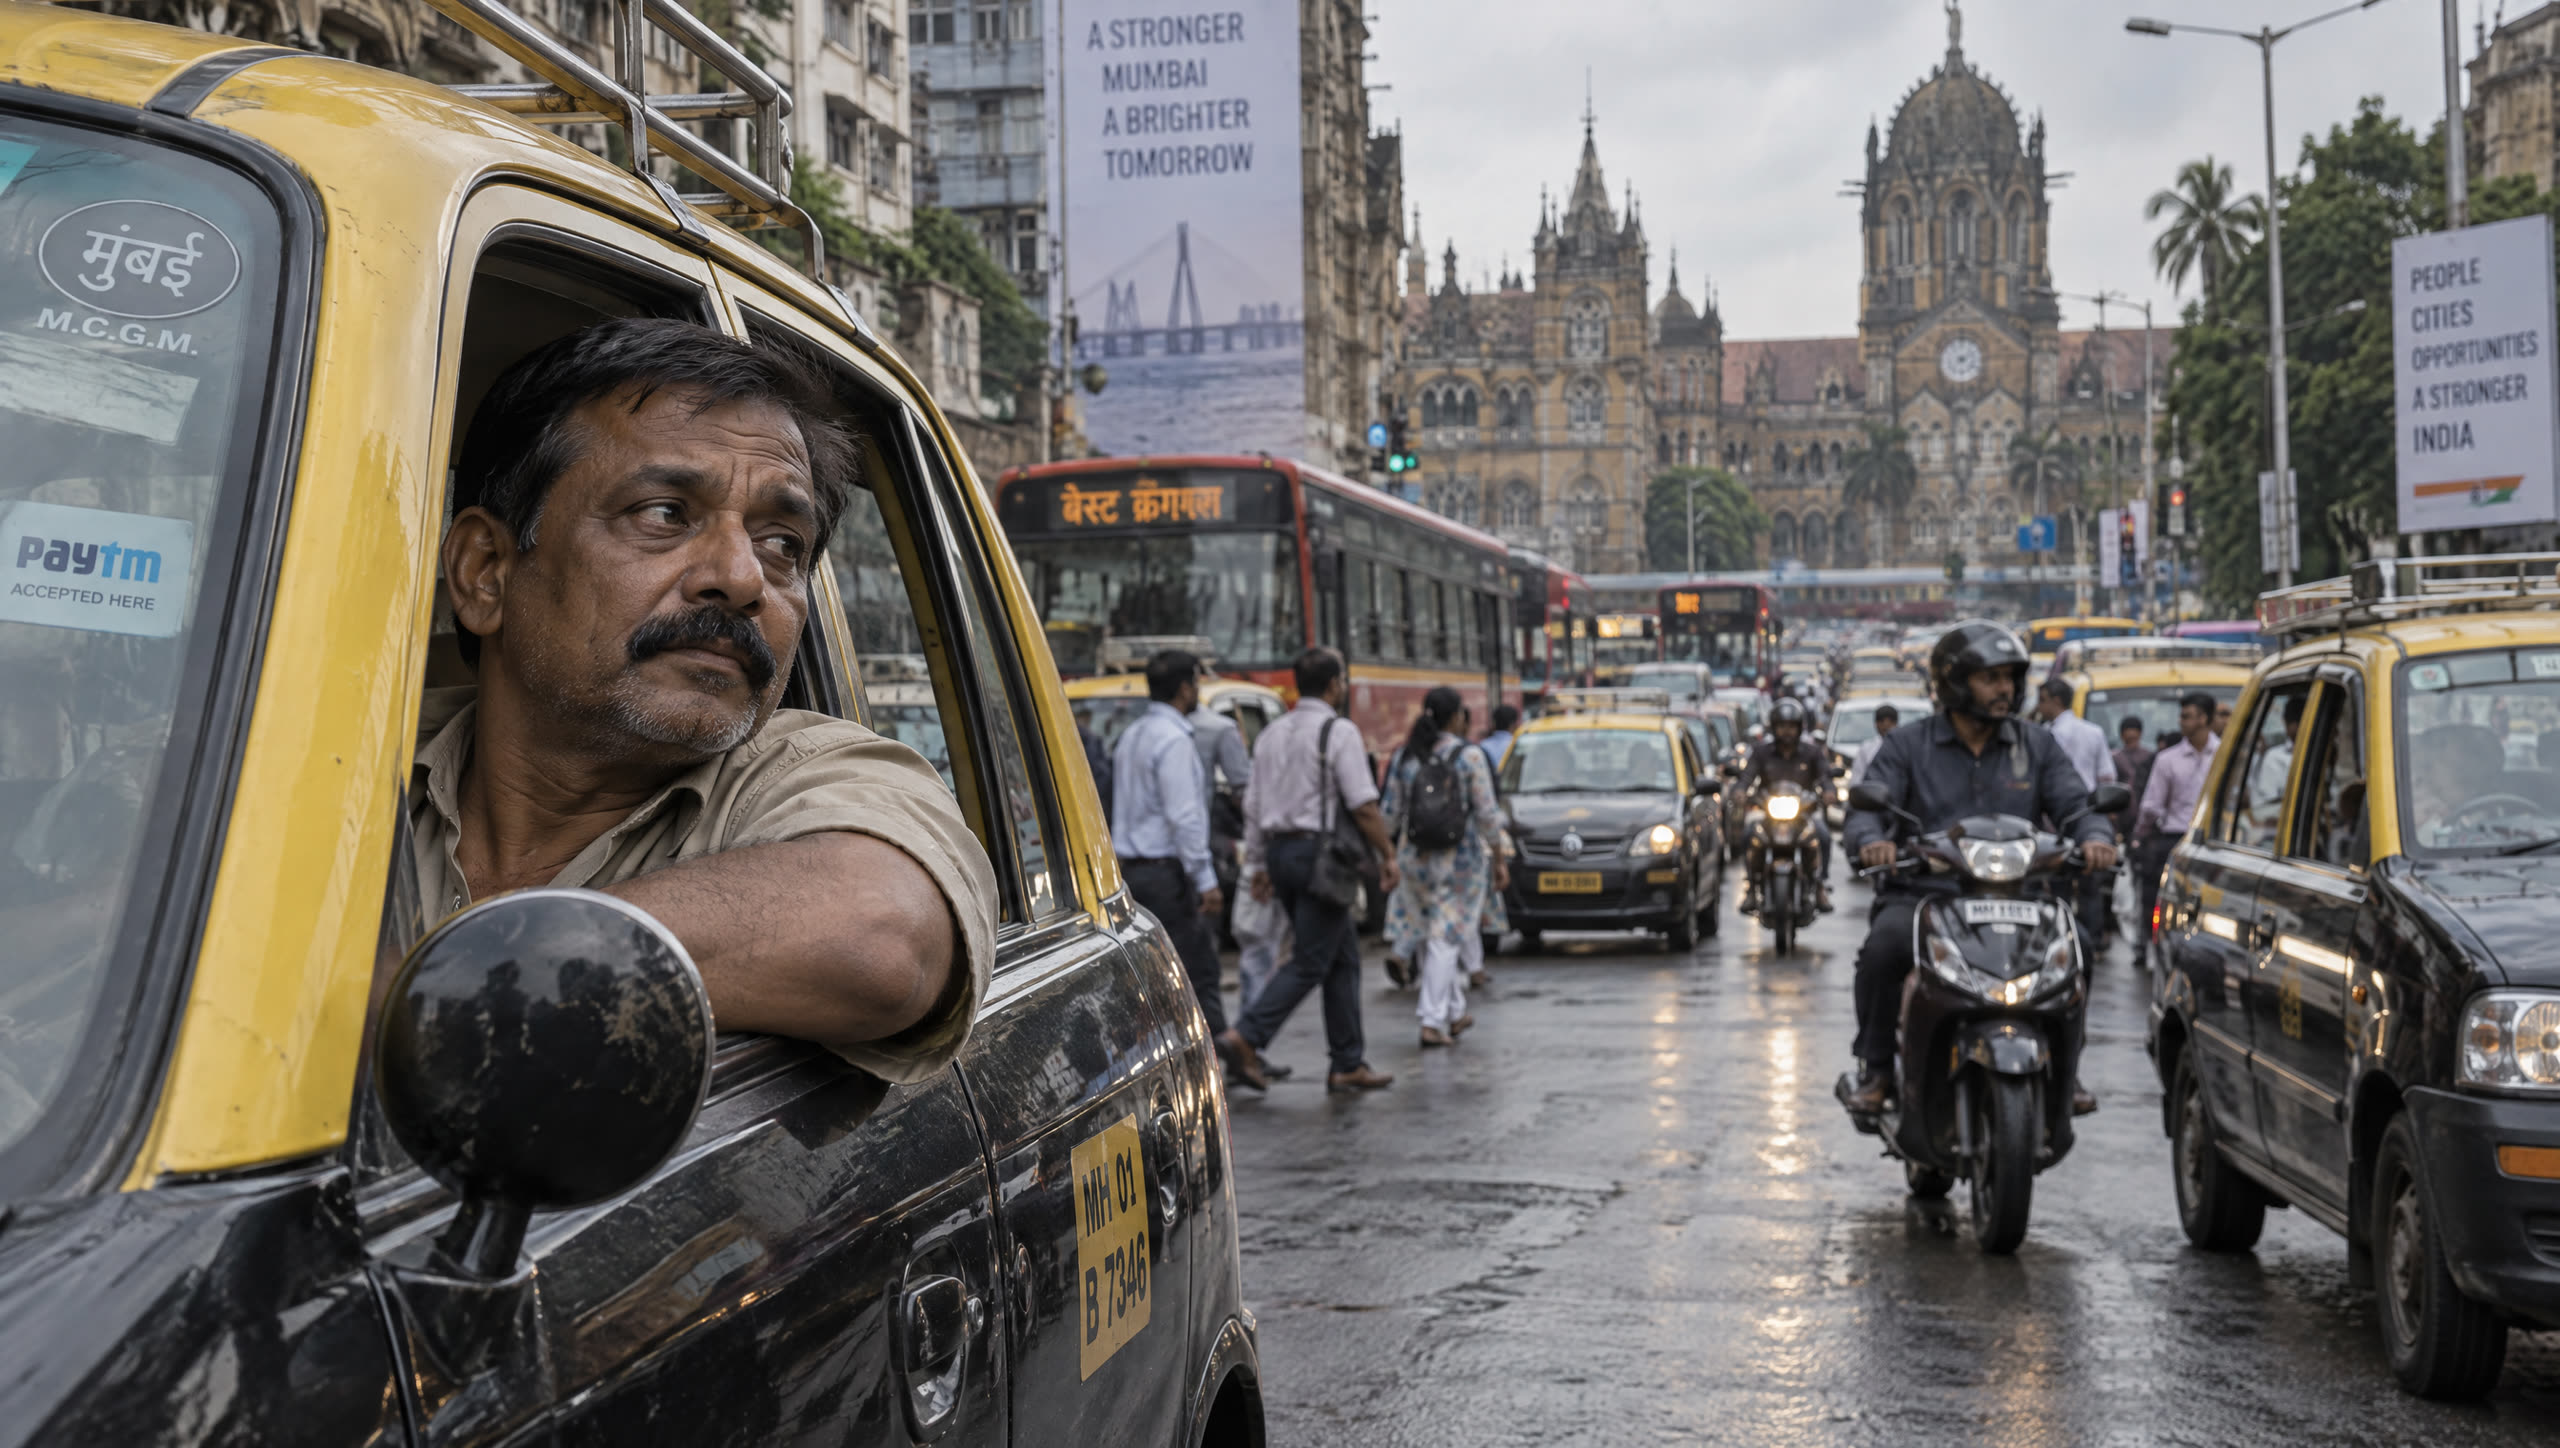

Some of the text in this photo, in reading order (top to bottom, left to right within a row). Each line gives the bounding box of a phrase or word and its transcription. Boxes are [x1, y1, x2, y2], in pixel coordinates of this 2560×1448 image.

[1087, 12, 1245, 50] A STRONGER
[1102, 58, 1208, 93] MUMBAI
[1102, 98, 1250, 137] A BRIGHTER
[1103, 142, 1254, 180] TOMORROW
[77, 223, 205, 297] मुंबई
[2409, 257, 2481, 294] PEOPLE
[36, 307, 198, 356] M.C.G.M.
[2410, 299, 2474, 334] CITIES
[2411, 373, 2529, 413] A STRONGER
[2412, 418, 2476, 454] INDIA
[10, 582, 156, 612] ACCEPTED HERE
[1081, 1146, 1137, 1238] MH 01
[1084, 1230, 1147, 1347] B 7346
